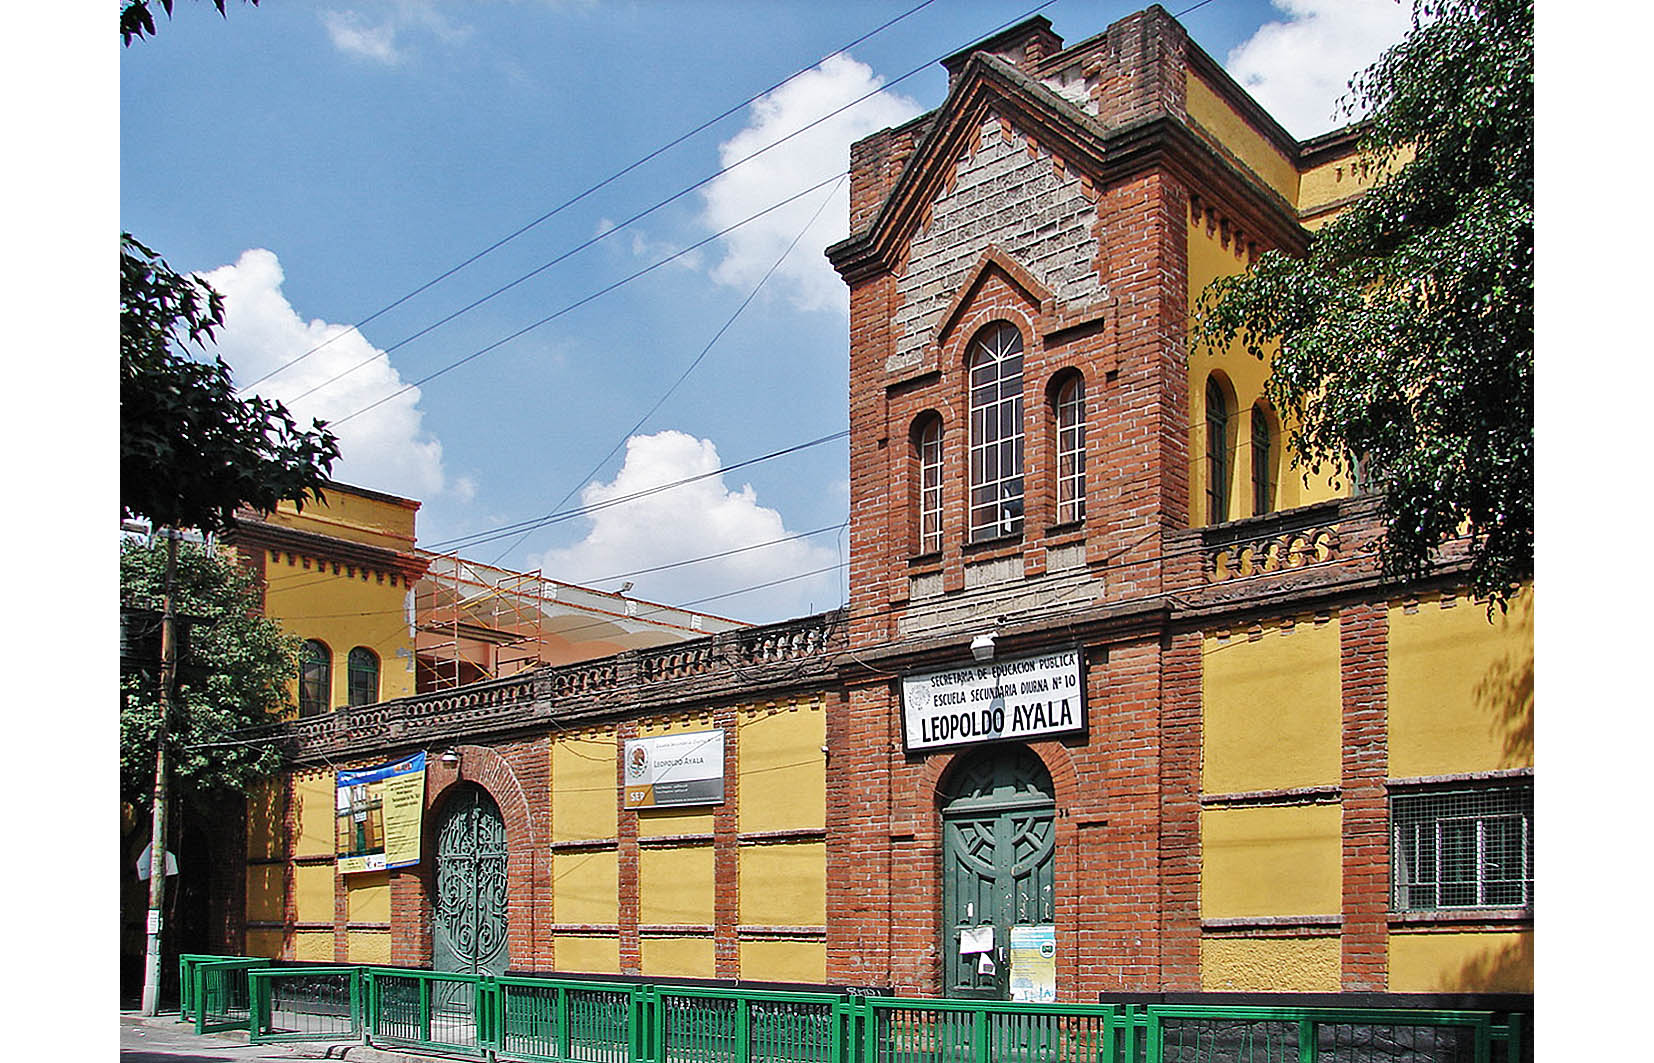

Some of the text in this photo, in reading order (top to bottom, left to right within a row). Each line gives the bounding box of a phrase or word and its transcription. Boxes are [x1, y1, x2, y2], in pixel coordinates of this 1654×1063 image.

[930, 653, 1076, 688] SECRETARIA DE EDUCACION PUBLICA
[933, 691, 966, 708] ESCUELA
[970, 684, 1018, 702] SECUNDARIA
[1020, 679, 1049, 694] DIURNA
[1064, 674, 1076, 688] 10
[922, 698, 1072, 742] LEOPOLDO AYALA
[684, 757, 704, 765] AYALA
[630, 791, 645, 802] SEP
